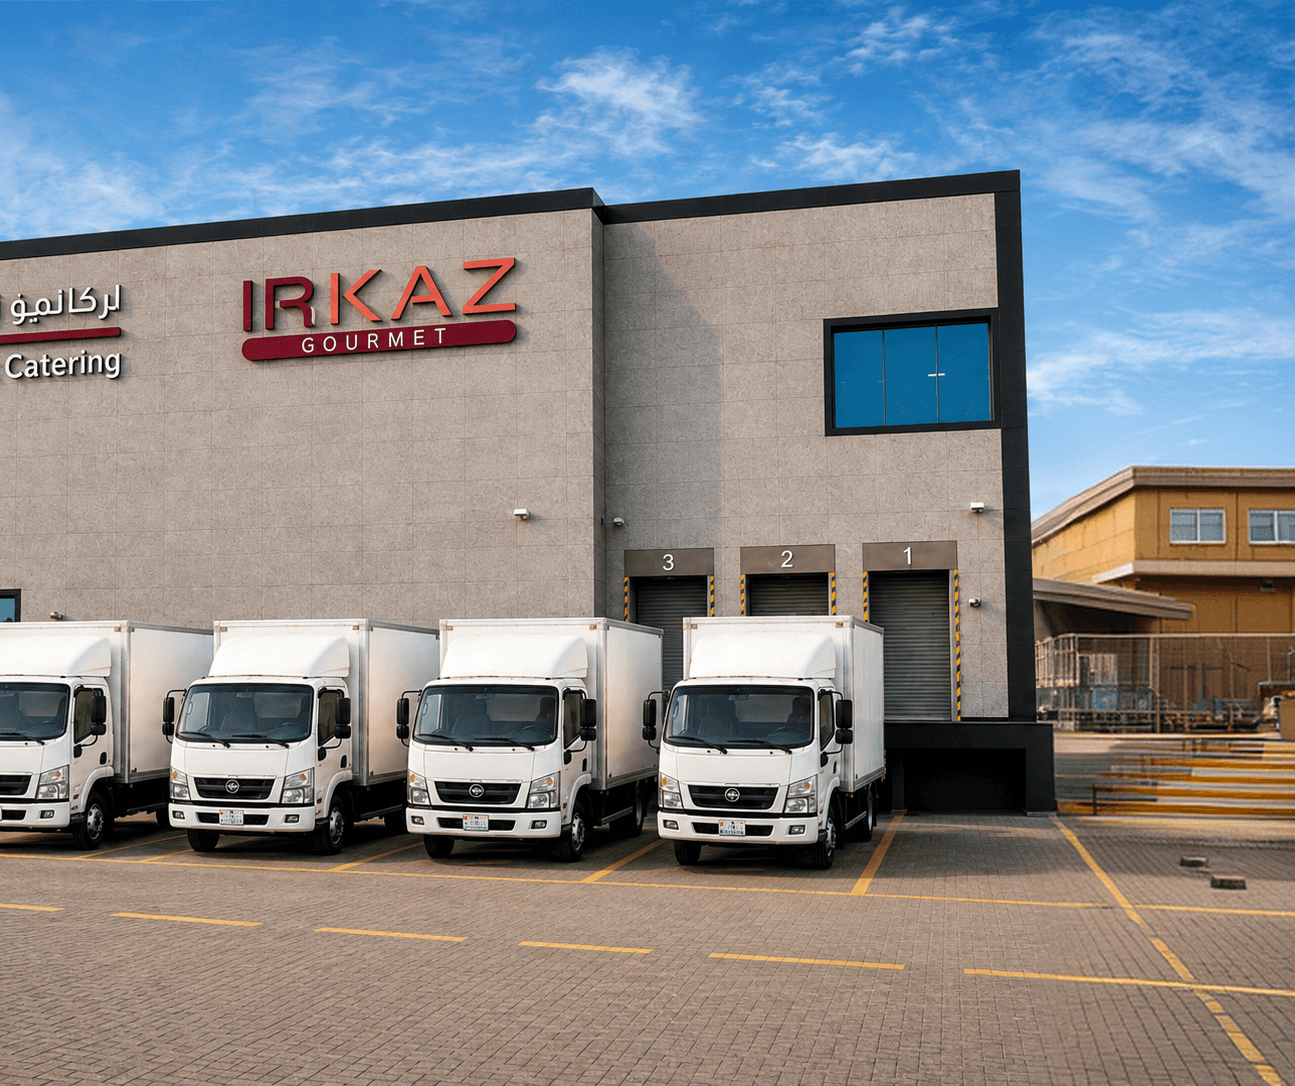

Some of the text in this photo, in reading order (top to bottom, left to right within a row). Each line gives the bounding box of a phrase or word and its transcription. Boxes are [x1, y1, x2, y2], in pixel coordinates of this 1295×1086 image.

[242, 257, 517, 332] IRKAZ
[301, 327, 448, 353] GOURMET
[4, 349, 122, 380] Catering
[662, 553, 675, 572] 3
[780, 549, 795, 569] 2
[902, 545, 913, 566] 1
